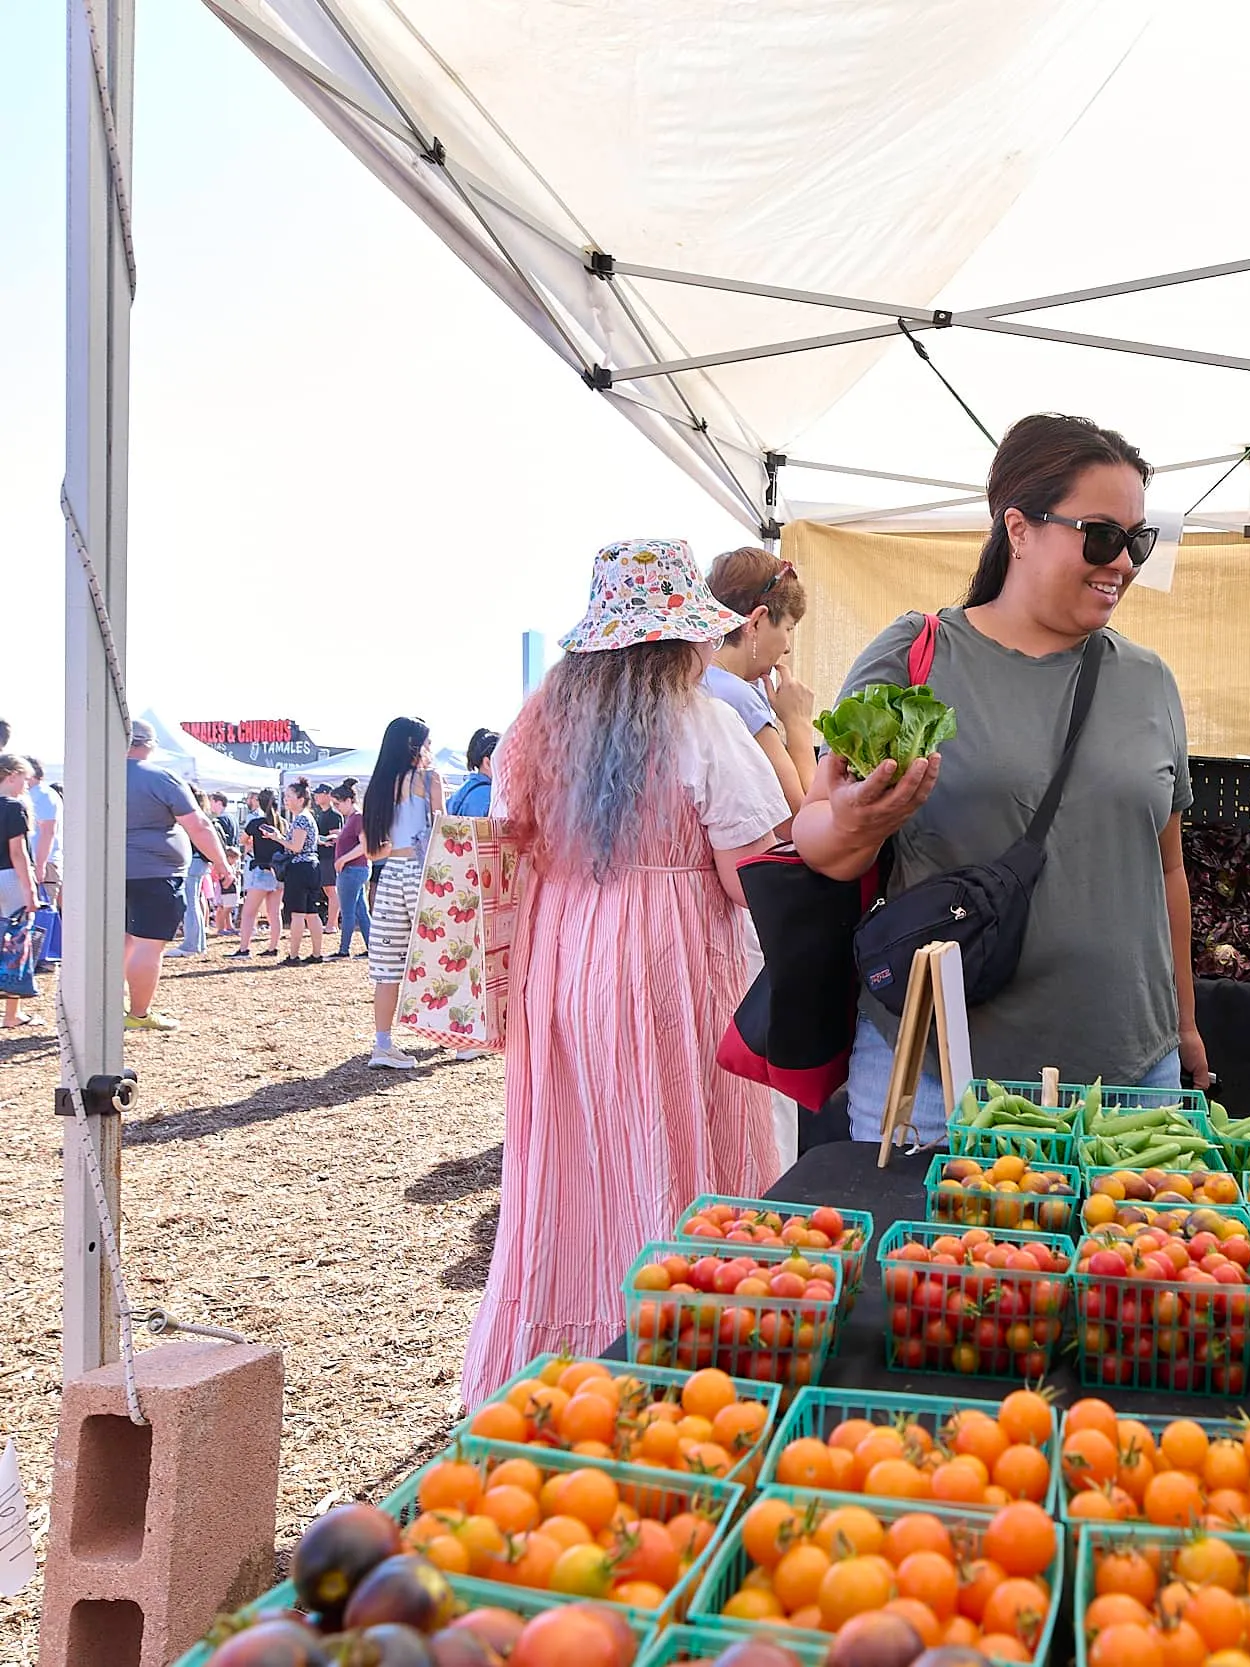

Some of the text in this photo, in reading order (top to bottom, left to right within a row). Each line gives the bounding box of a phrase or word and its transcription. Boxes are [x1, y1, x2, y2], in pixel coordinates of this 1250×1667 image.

[227, 723, 235, 743] &
[238, 719, 292, 743] CHURROS
[262, 740, 311, 754] TAMALES
